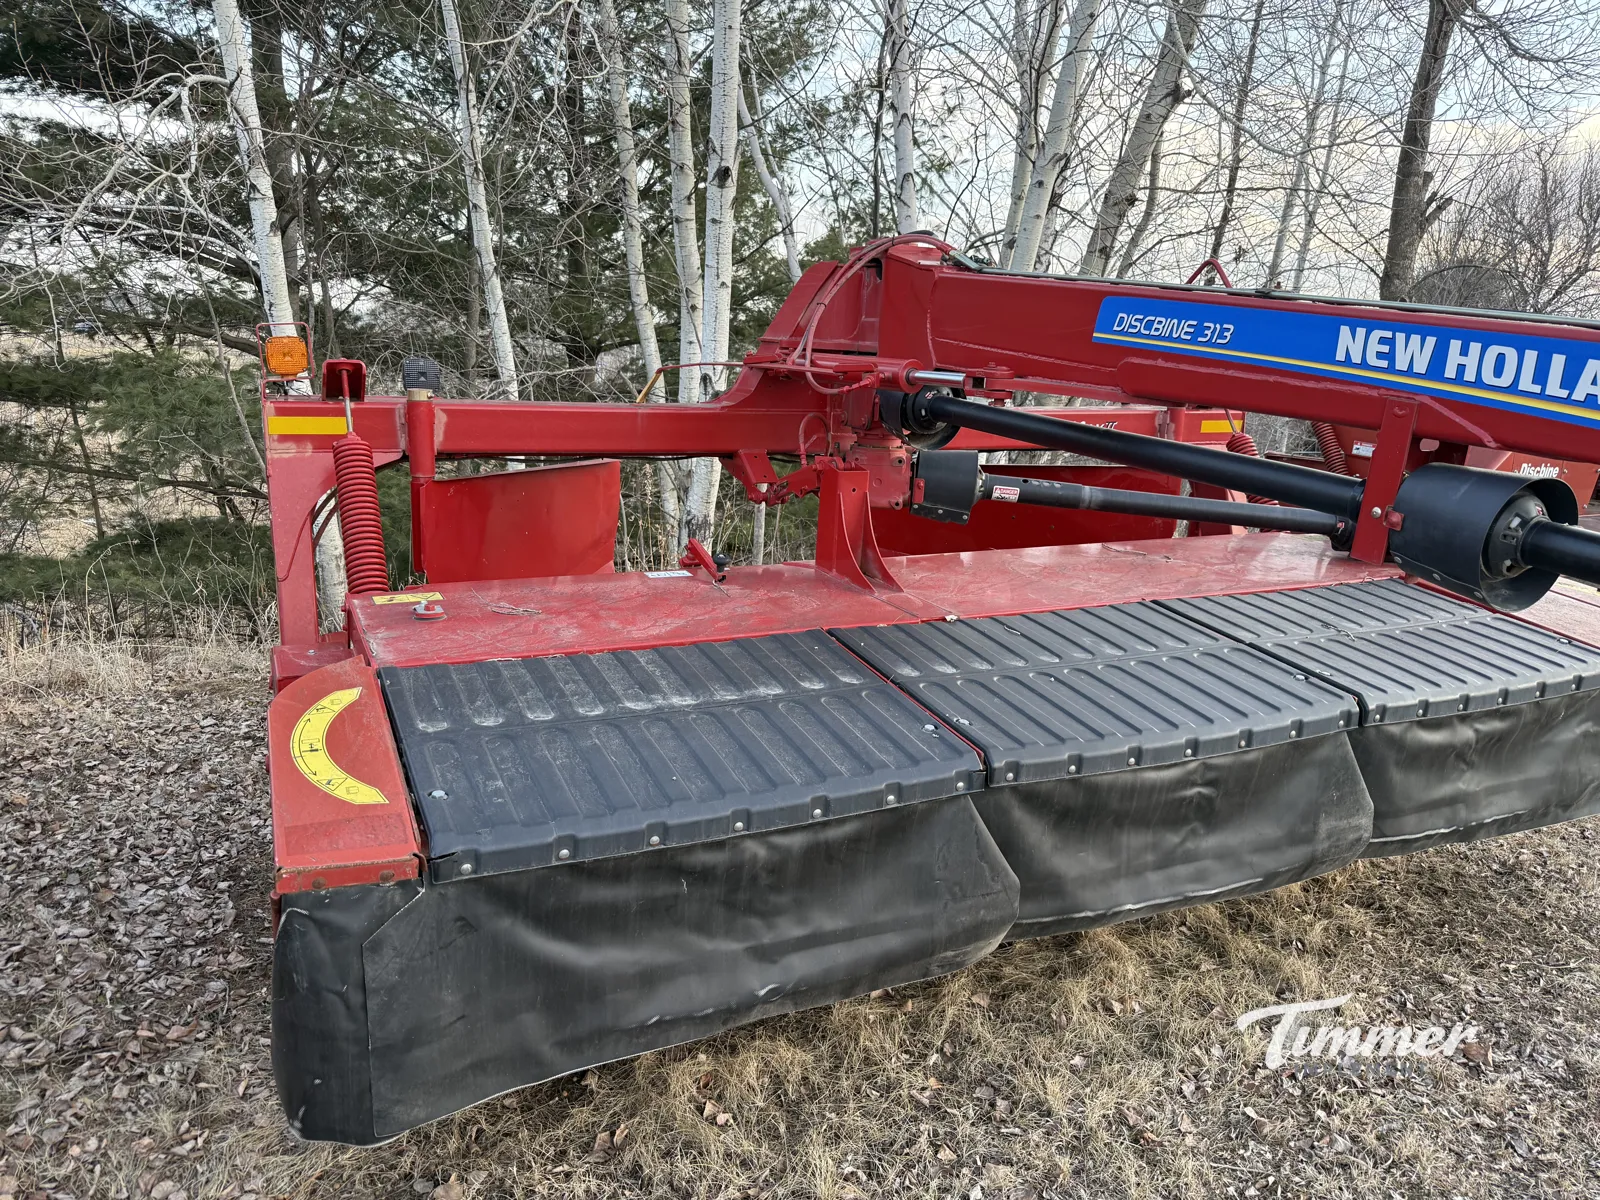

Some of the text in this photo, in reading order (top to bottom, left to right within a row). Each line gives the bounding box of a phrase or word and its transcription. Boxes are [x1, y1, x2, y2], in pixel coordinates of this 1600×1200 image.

[1113, 312, 1234, 344] DISCBINE 313
[1335, 325, 1438, 375] NEW
[1520, 463, 1560, 478] Discbine
